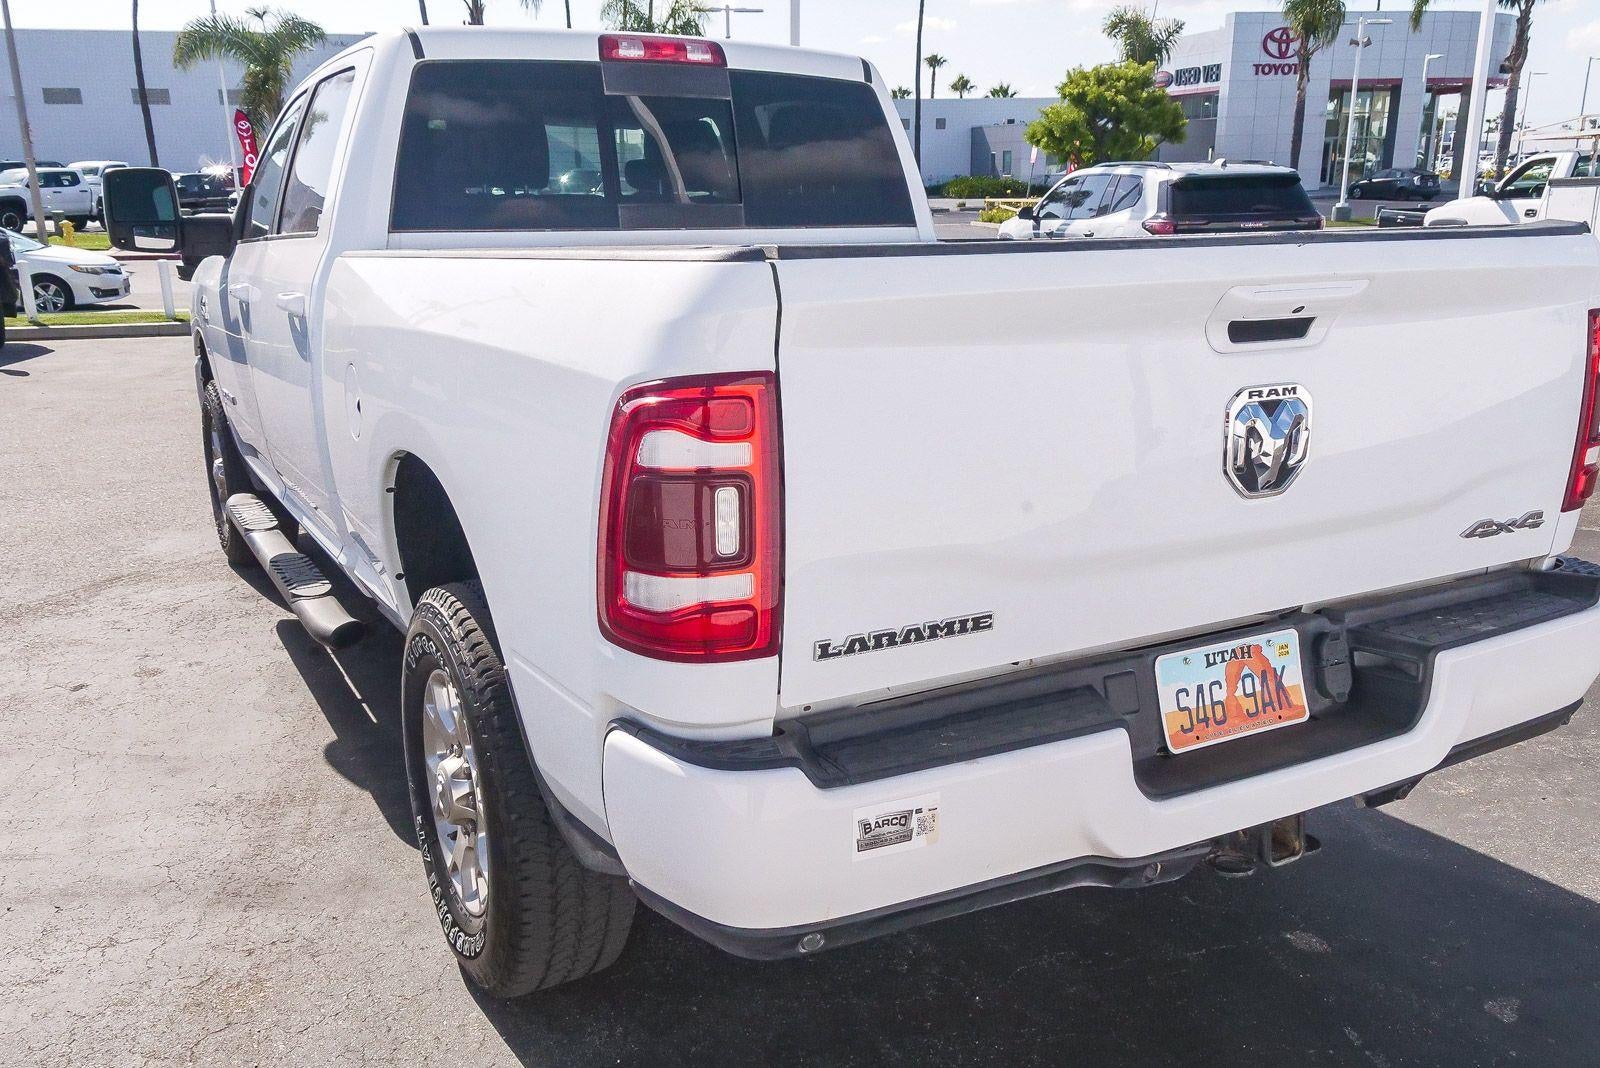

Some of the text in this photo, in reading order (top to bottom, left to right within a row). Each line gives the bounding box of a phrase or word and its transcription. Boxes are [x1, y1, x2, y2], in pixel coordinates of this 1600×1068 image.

[1174, 66, 1201, 86] USED
[1247, 386, 1298, 400] RAM
[813, 611, 994, 662] LARAMIE
[1204, 644, 1254, 669] UTAH
[1175, 664, 1293, 735] S46 9AK
[862, 814, 908, 836] BARCO
